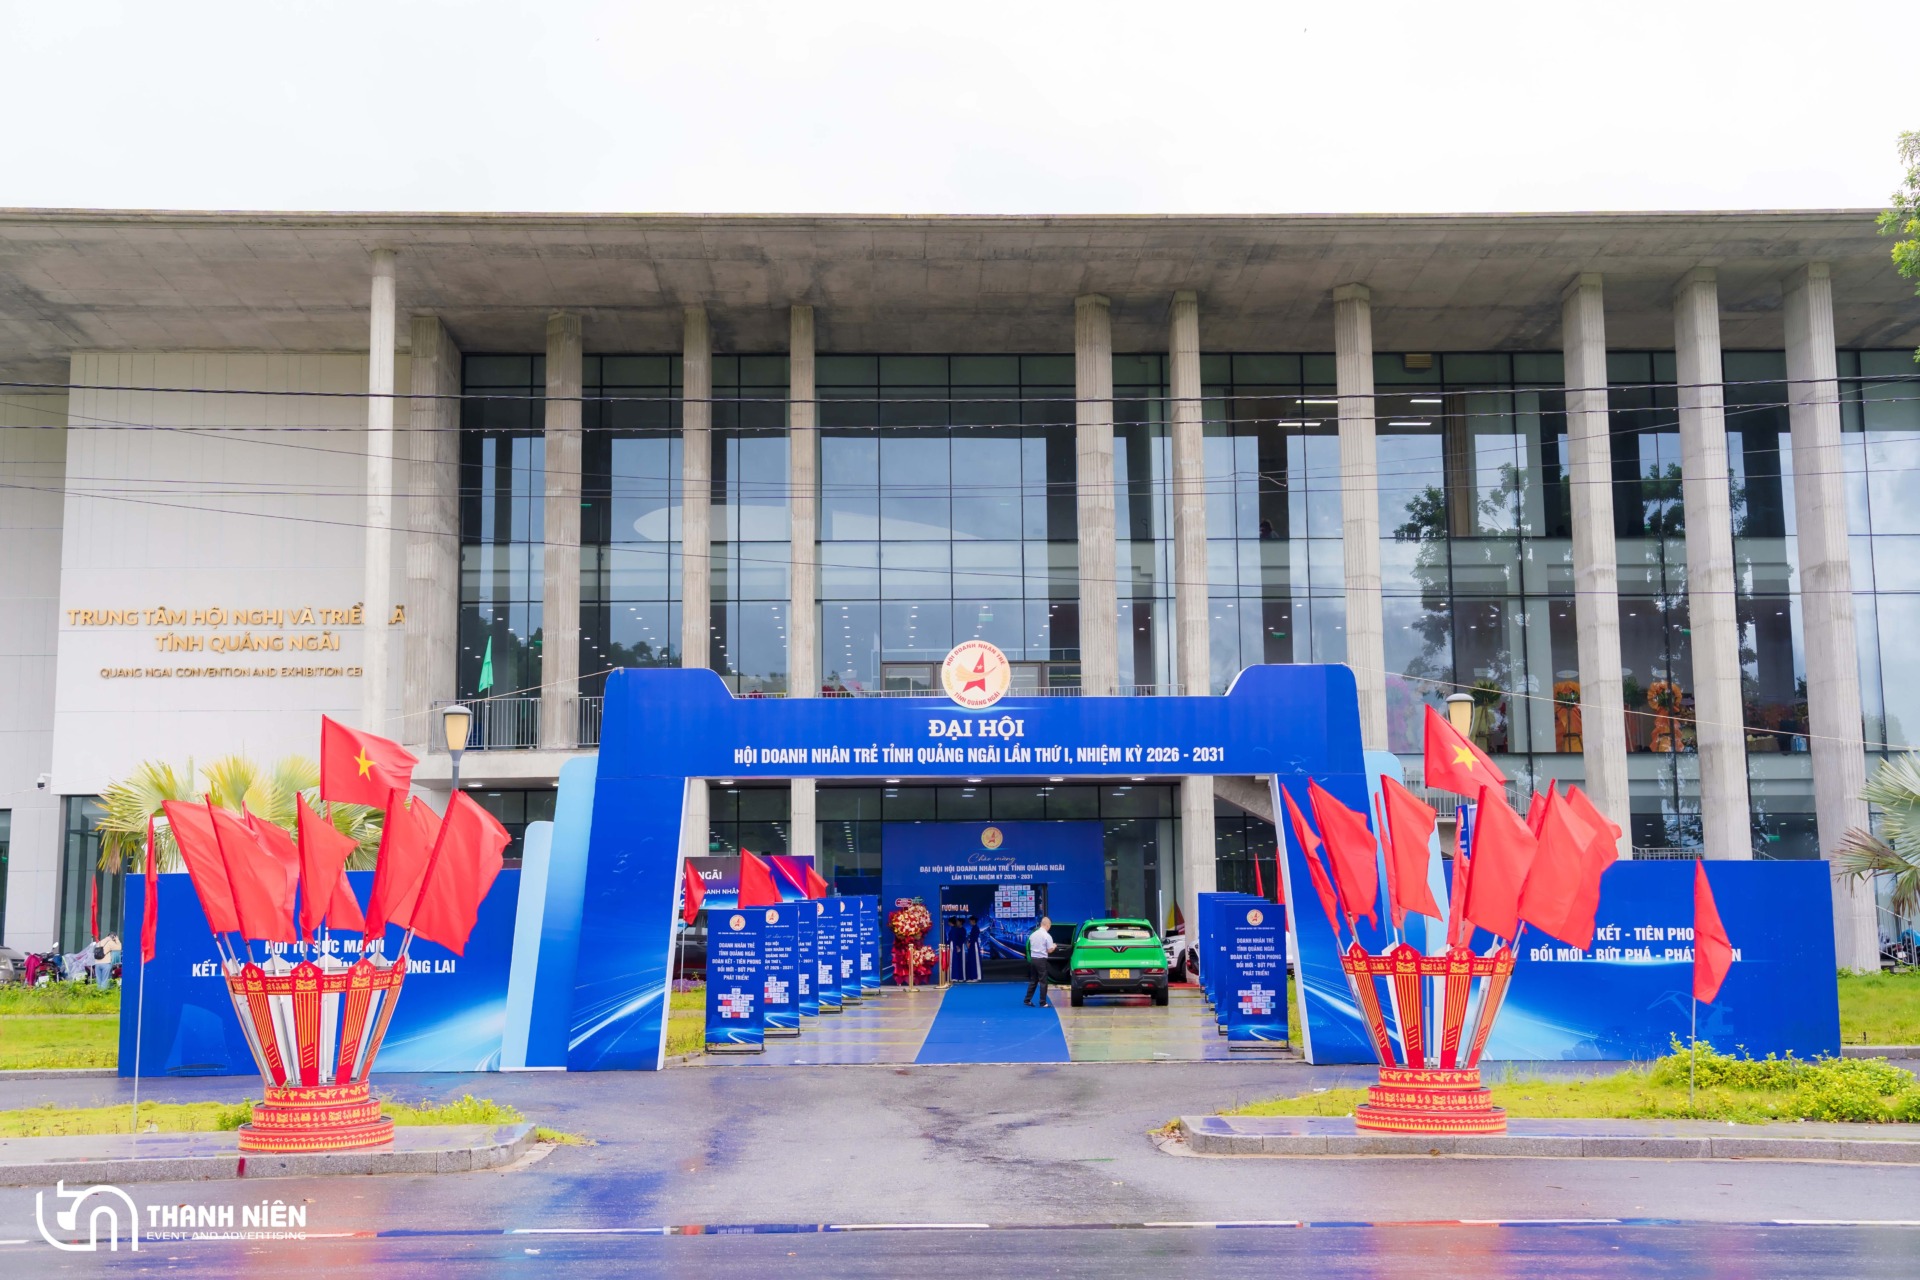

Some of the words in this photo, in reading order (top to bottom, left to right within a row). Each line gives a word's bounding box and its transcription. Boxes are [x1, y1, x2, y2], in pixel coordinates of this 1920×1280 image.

[68, 609, 139, 626] TRUNG
[144, 605, 187, 626] TÂM
[192, 606, 228, 630] HỘI
[232, 608, 284, 629] NGHỊ
[288, 605, 316, 626] VÀ
[156, 632, 204, 652] TỈNH
[209, 631, 284, 654] QUẢNG
[289, 630, 340, 651] NGÃI
[954, 643, 976, 656] DOANH
[100, 668, 142, 680] QUANG
[146, 668, 173, 678] NGAI
[176, 667, 252, 678] CONVENTION
[252, 666, 277, 678] AND
[280, 666, 344, 678] EXHIBITION
[928, 719, 972, 741] ĐẠI
[978, 715, 1025, 741] HỘI
[734, 746, 758, 767] HỘI
[761, 748, 808, 764] DOANH
[811, 745, 850, 764] NHÂN
[854, 743, 878, 763] TRẺ
[882, 743, 914, 763] TỈNH
[917, 742, 964, 764] QUẢNG
[968, 744, 1000, 762] NGÃI
[1004, 742, 1031, 762] LẦN
[1034, 744, 1062, 762] THỨ
[1064, 748, 1073, 764] I,
[1076, 744, 1122, 766] NHIỆM
[1126, 744, 1142, 762] KỲ
[1146, 746, 1180, 762] 2026
[1192, 746, 1224, 762] 2031
[968, 852, 992, 864] Chào
[920, 866, 930, 874] ĐẠI
[932, 865, 943, 874] HỘI
[944, 865, 955, 874] HỘI
[979, 864, 997, 872] NHÂN
[1026, 862, 1048, 872] QUẢNG
[1597, 924, 1622, 940] KẾT
[1634, 924, 1664, 940] TIÊN
[1530, 943, 1553, 962] ĐỔI
[1557, 946, 1583, 962] MỚI
[1596, 946, 1621, 962] BỨT
[1625, 946, 1652, 962] PHÁ
[192, 958, 218, 977] KẾT
[434, 959, 456, 973] LAI
